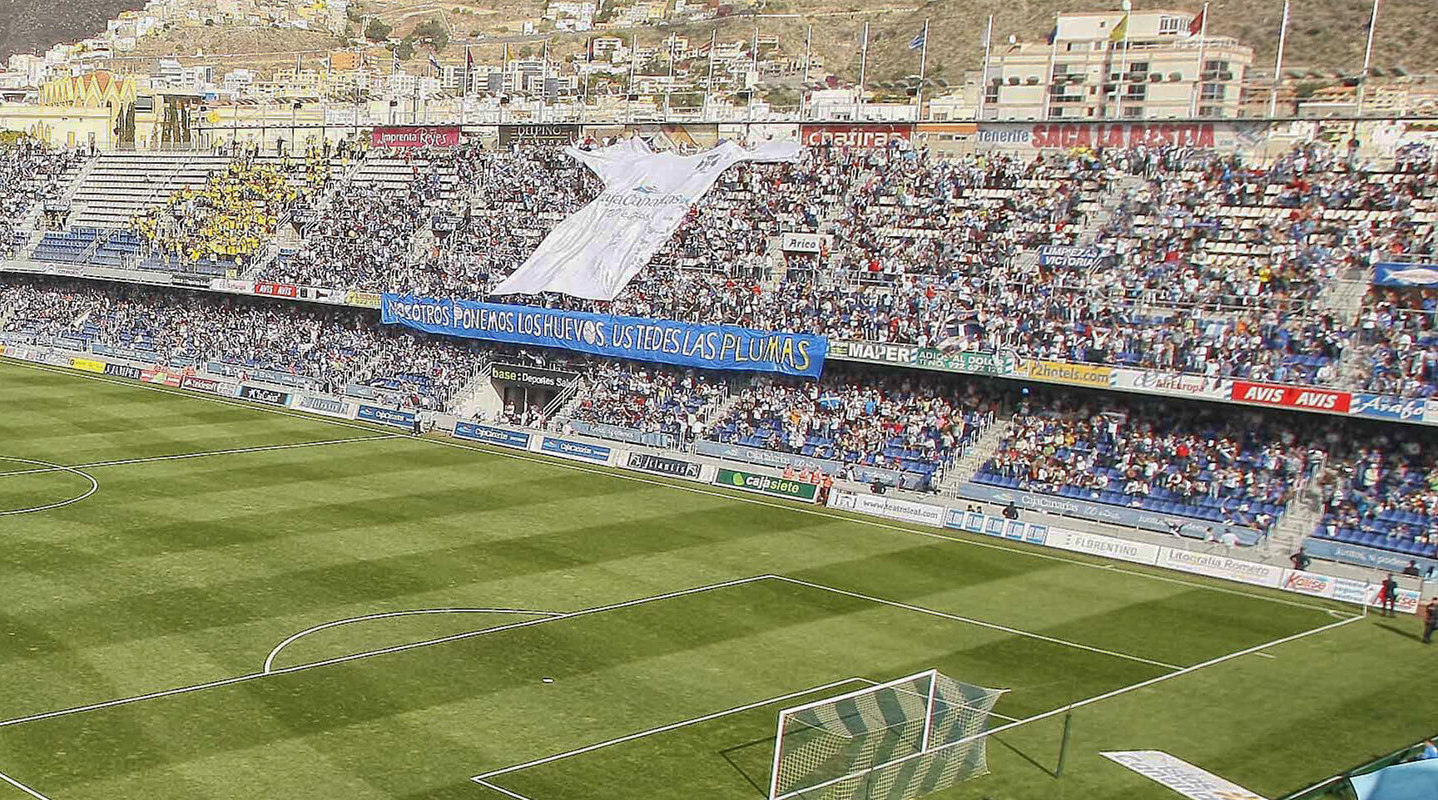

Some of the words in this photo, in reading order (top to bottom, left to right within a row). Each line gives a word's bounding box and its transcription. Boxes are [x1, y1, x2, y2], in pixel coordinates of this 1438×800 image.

[977, 129, 1029, 143] Tenerife
[1031, 124, 1093, 148] SACA
[790, 239, 816, 248] Arico
[1045, 255, 1094, 268] VICTORIA
[453, 302, 514, 333] PONEMOS
[517, 312, 542, 336] LOS
[682, 330, 719, 360] LAS
[719, 332, 811, 371] PLUMAS
[1244, 386, 1285, 403] AVIS
[1295, 392, 1339, 409] AVIS
[746, 475, 800, 493] cajasiete
[1075, 537, 1138, 557] FLORENTINO
